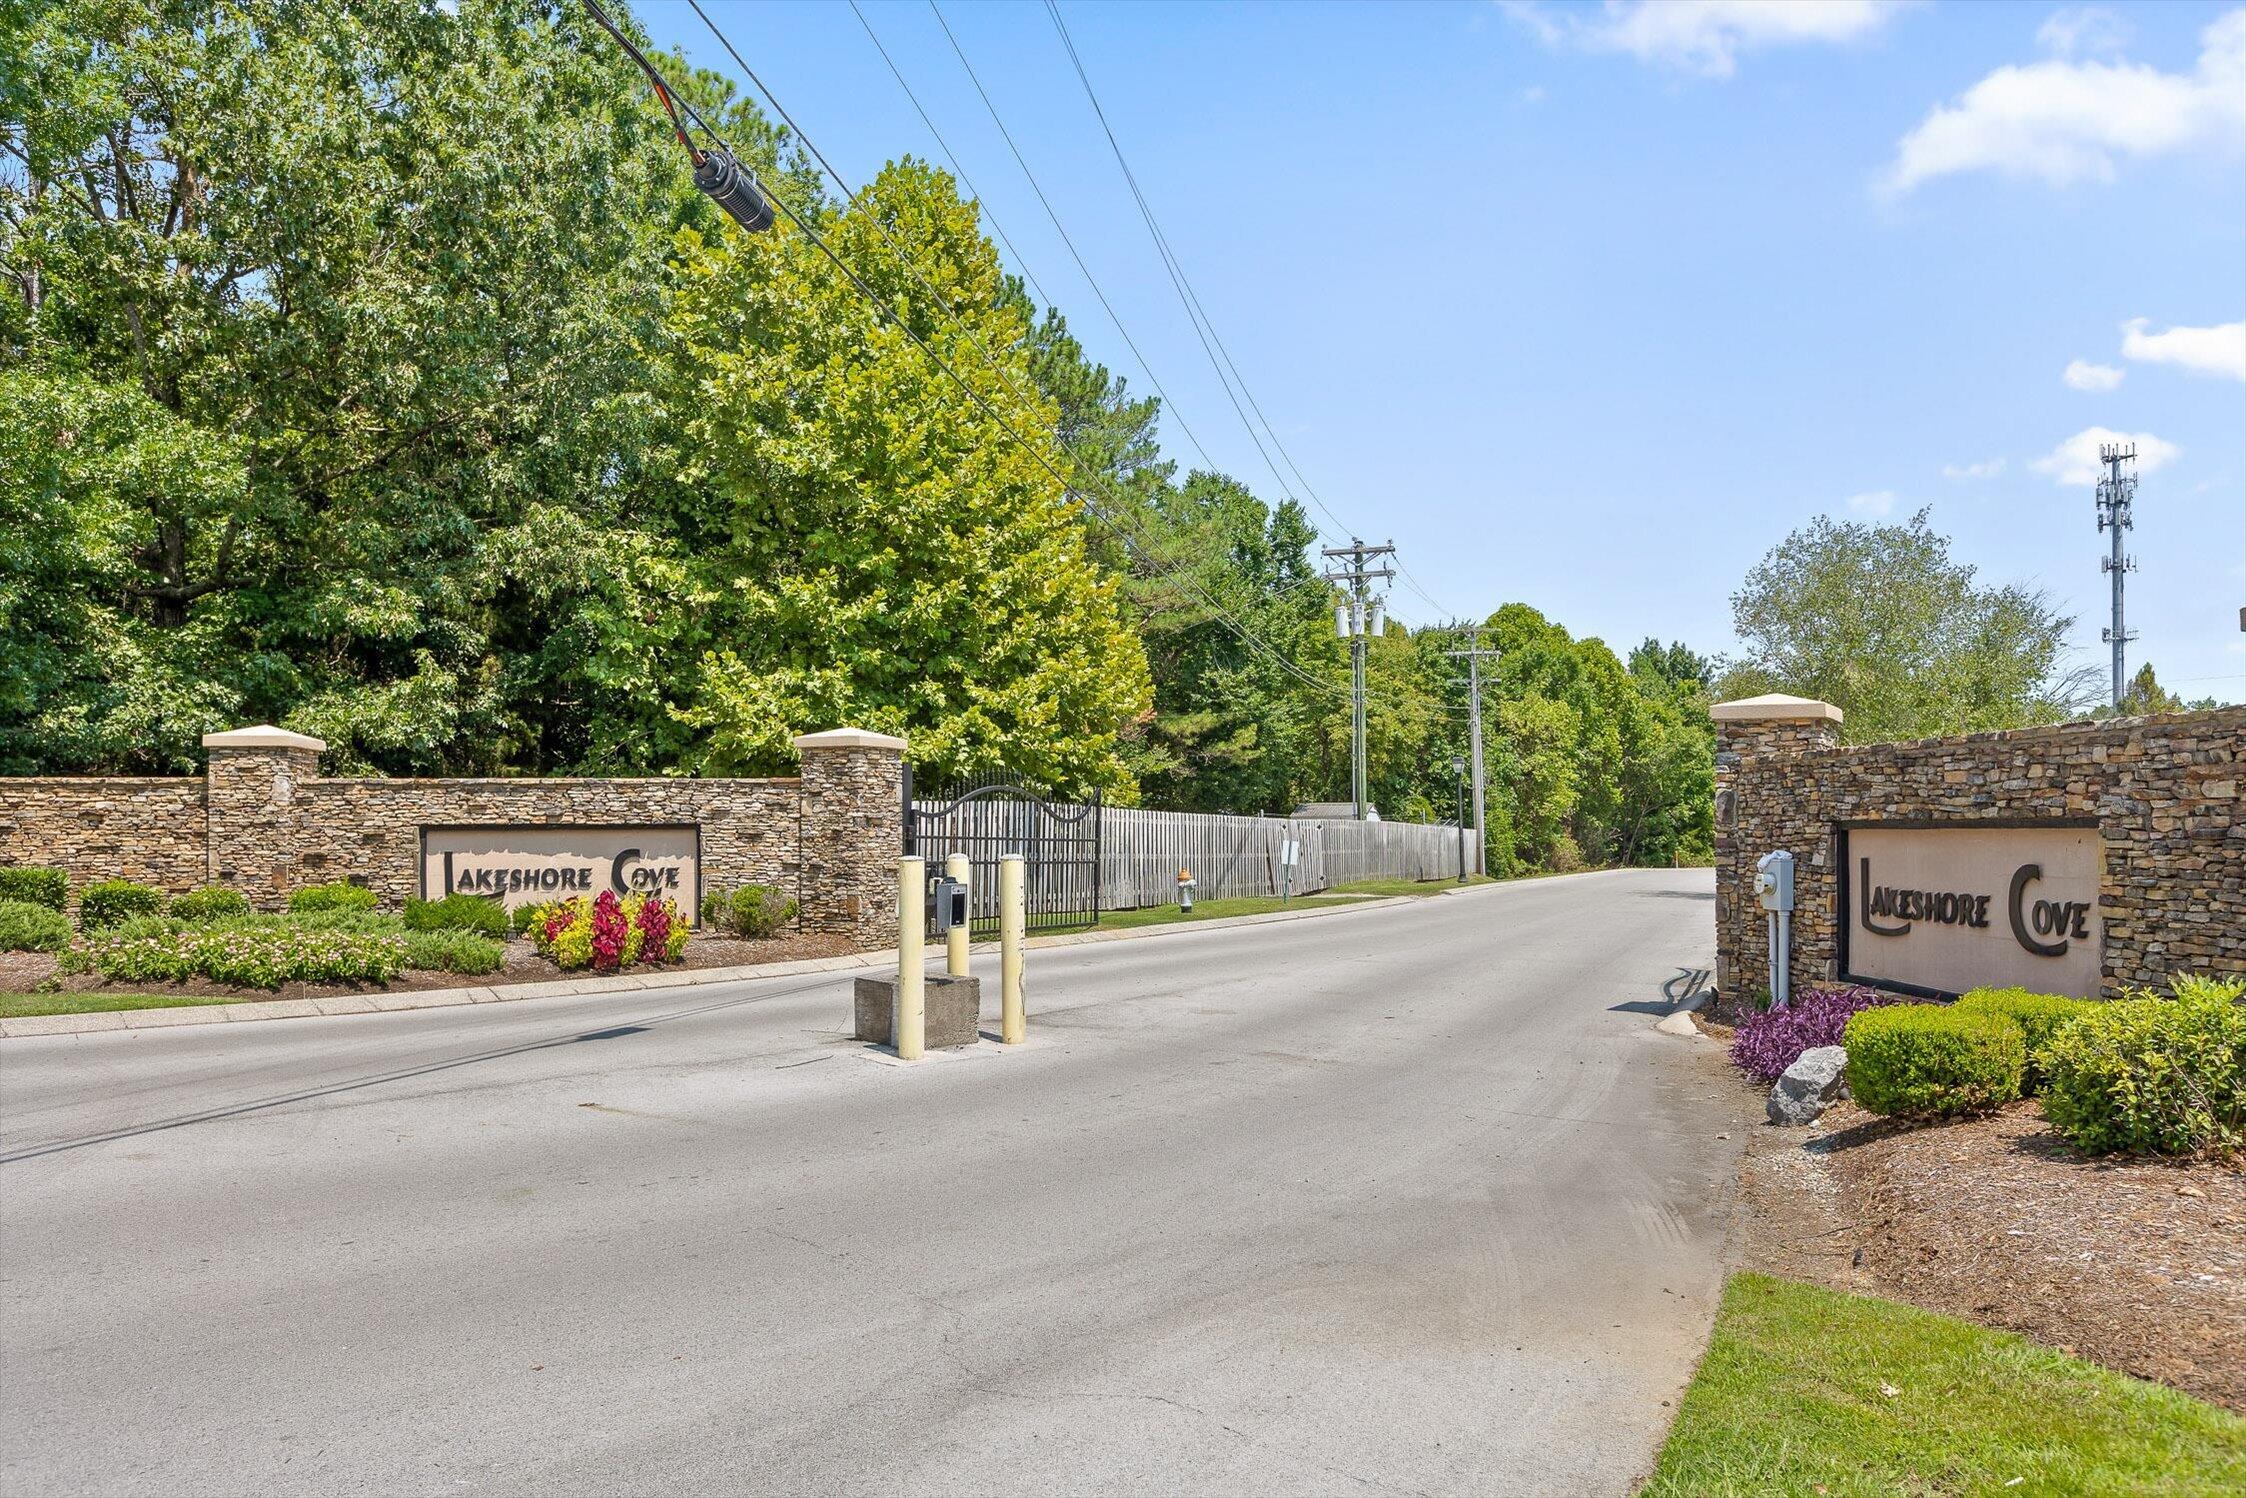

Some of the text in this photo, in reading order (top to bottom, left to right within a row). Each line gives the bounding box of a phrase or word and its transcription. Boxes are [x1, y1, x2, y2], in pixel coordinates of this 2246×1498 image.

[444, 848, 680, 898] LAKESHORE COVE
[1860, 857, 2091, 957] LAKESHORE COVE
